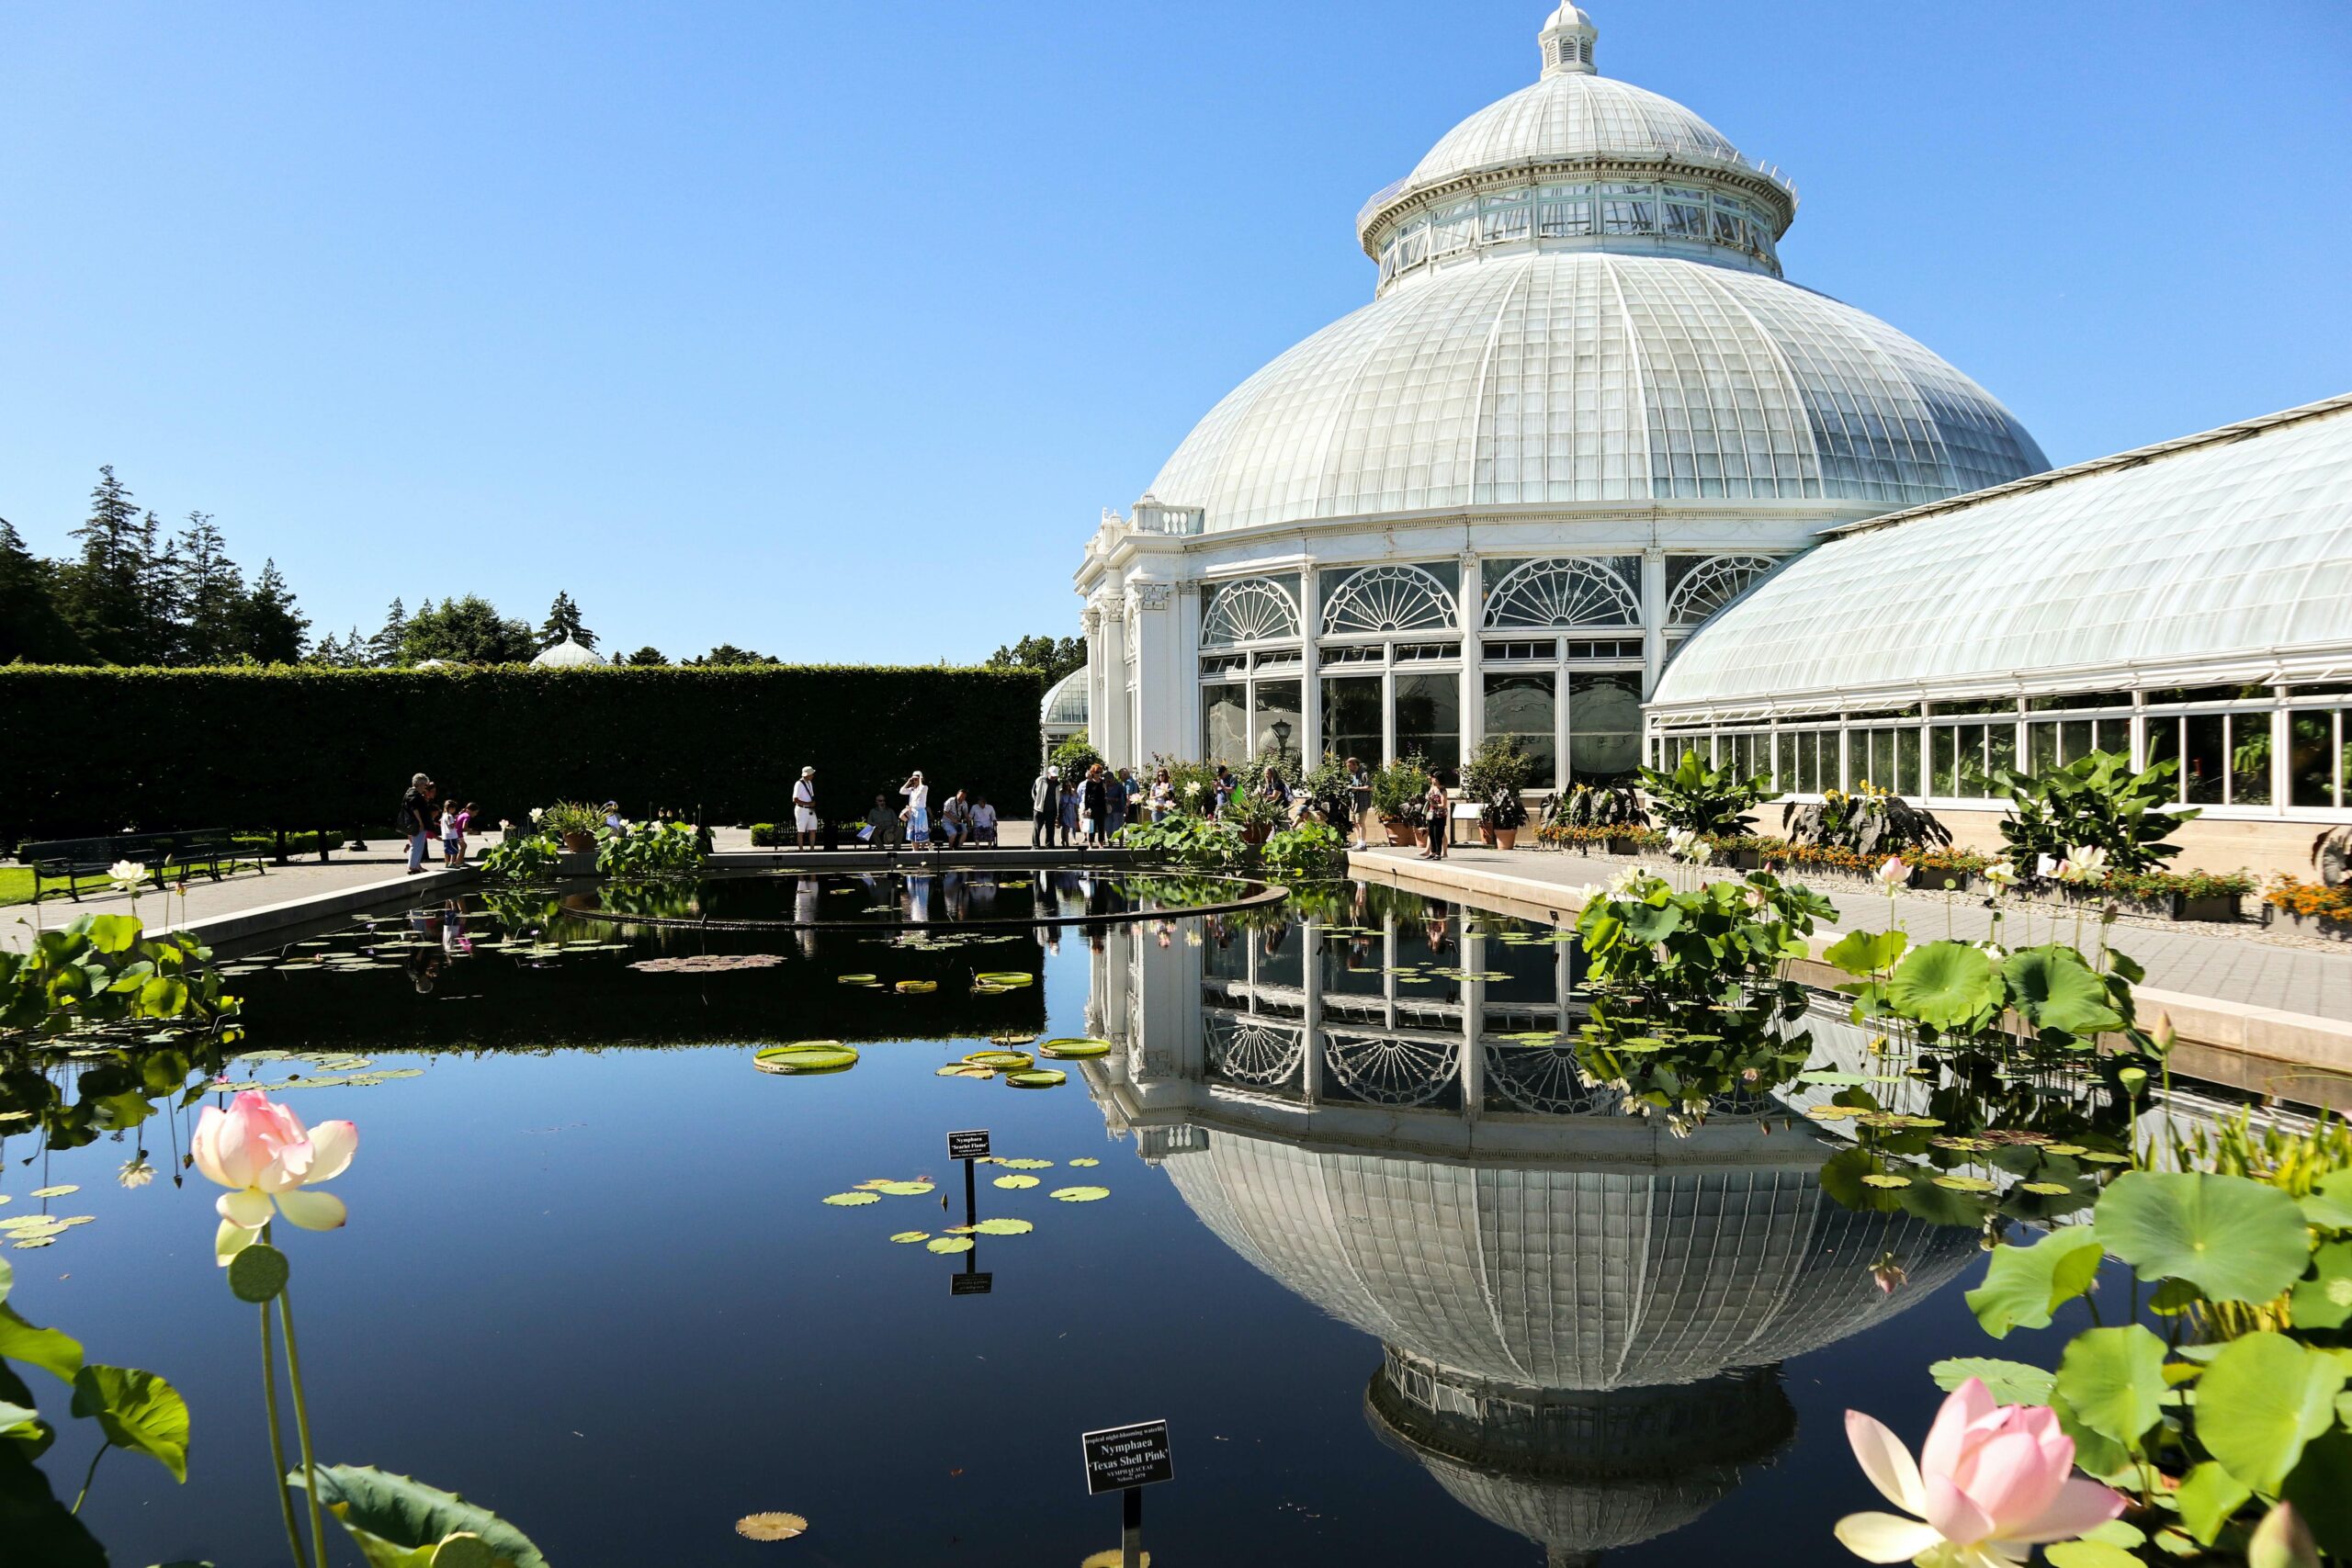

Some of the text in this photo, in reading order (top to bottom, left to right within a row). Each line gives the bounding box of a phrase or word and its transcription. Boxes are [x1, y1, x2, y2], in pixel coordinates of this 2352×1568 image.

[1085, 1436, 1104, 1444] tropical
[1105, 1430, 1143, 1441] night-blooming
[1102, 1439, 1153, 1455] Nymphaea
[1120, 1454, 1142, 1466] Shell
